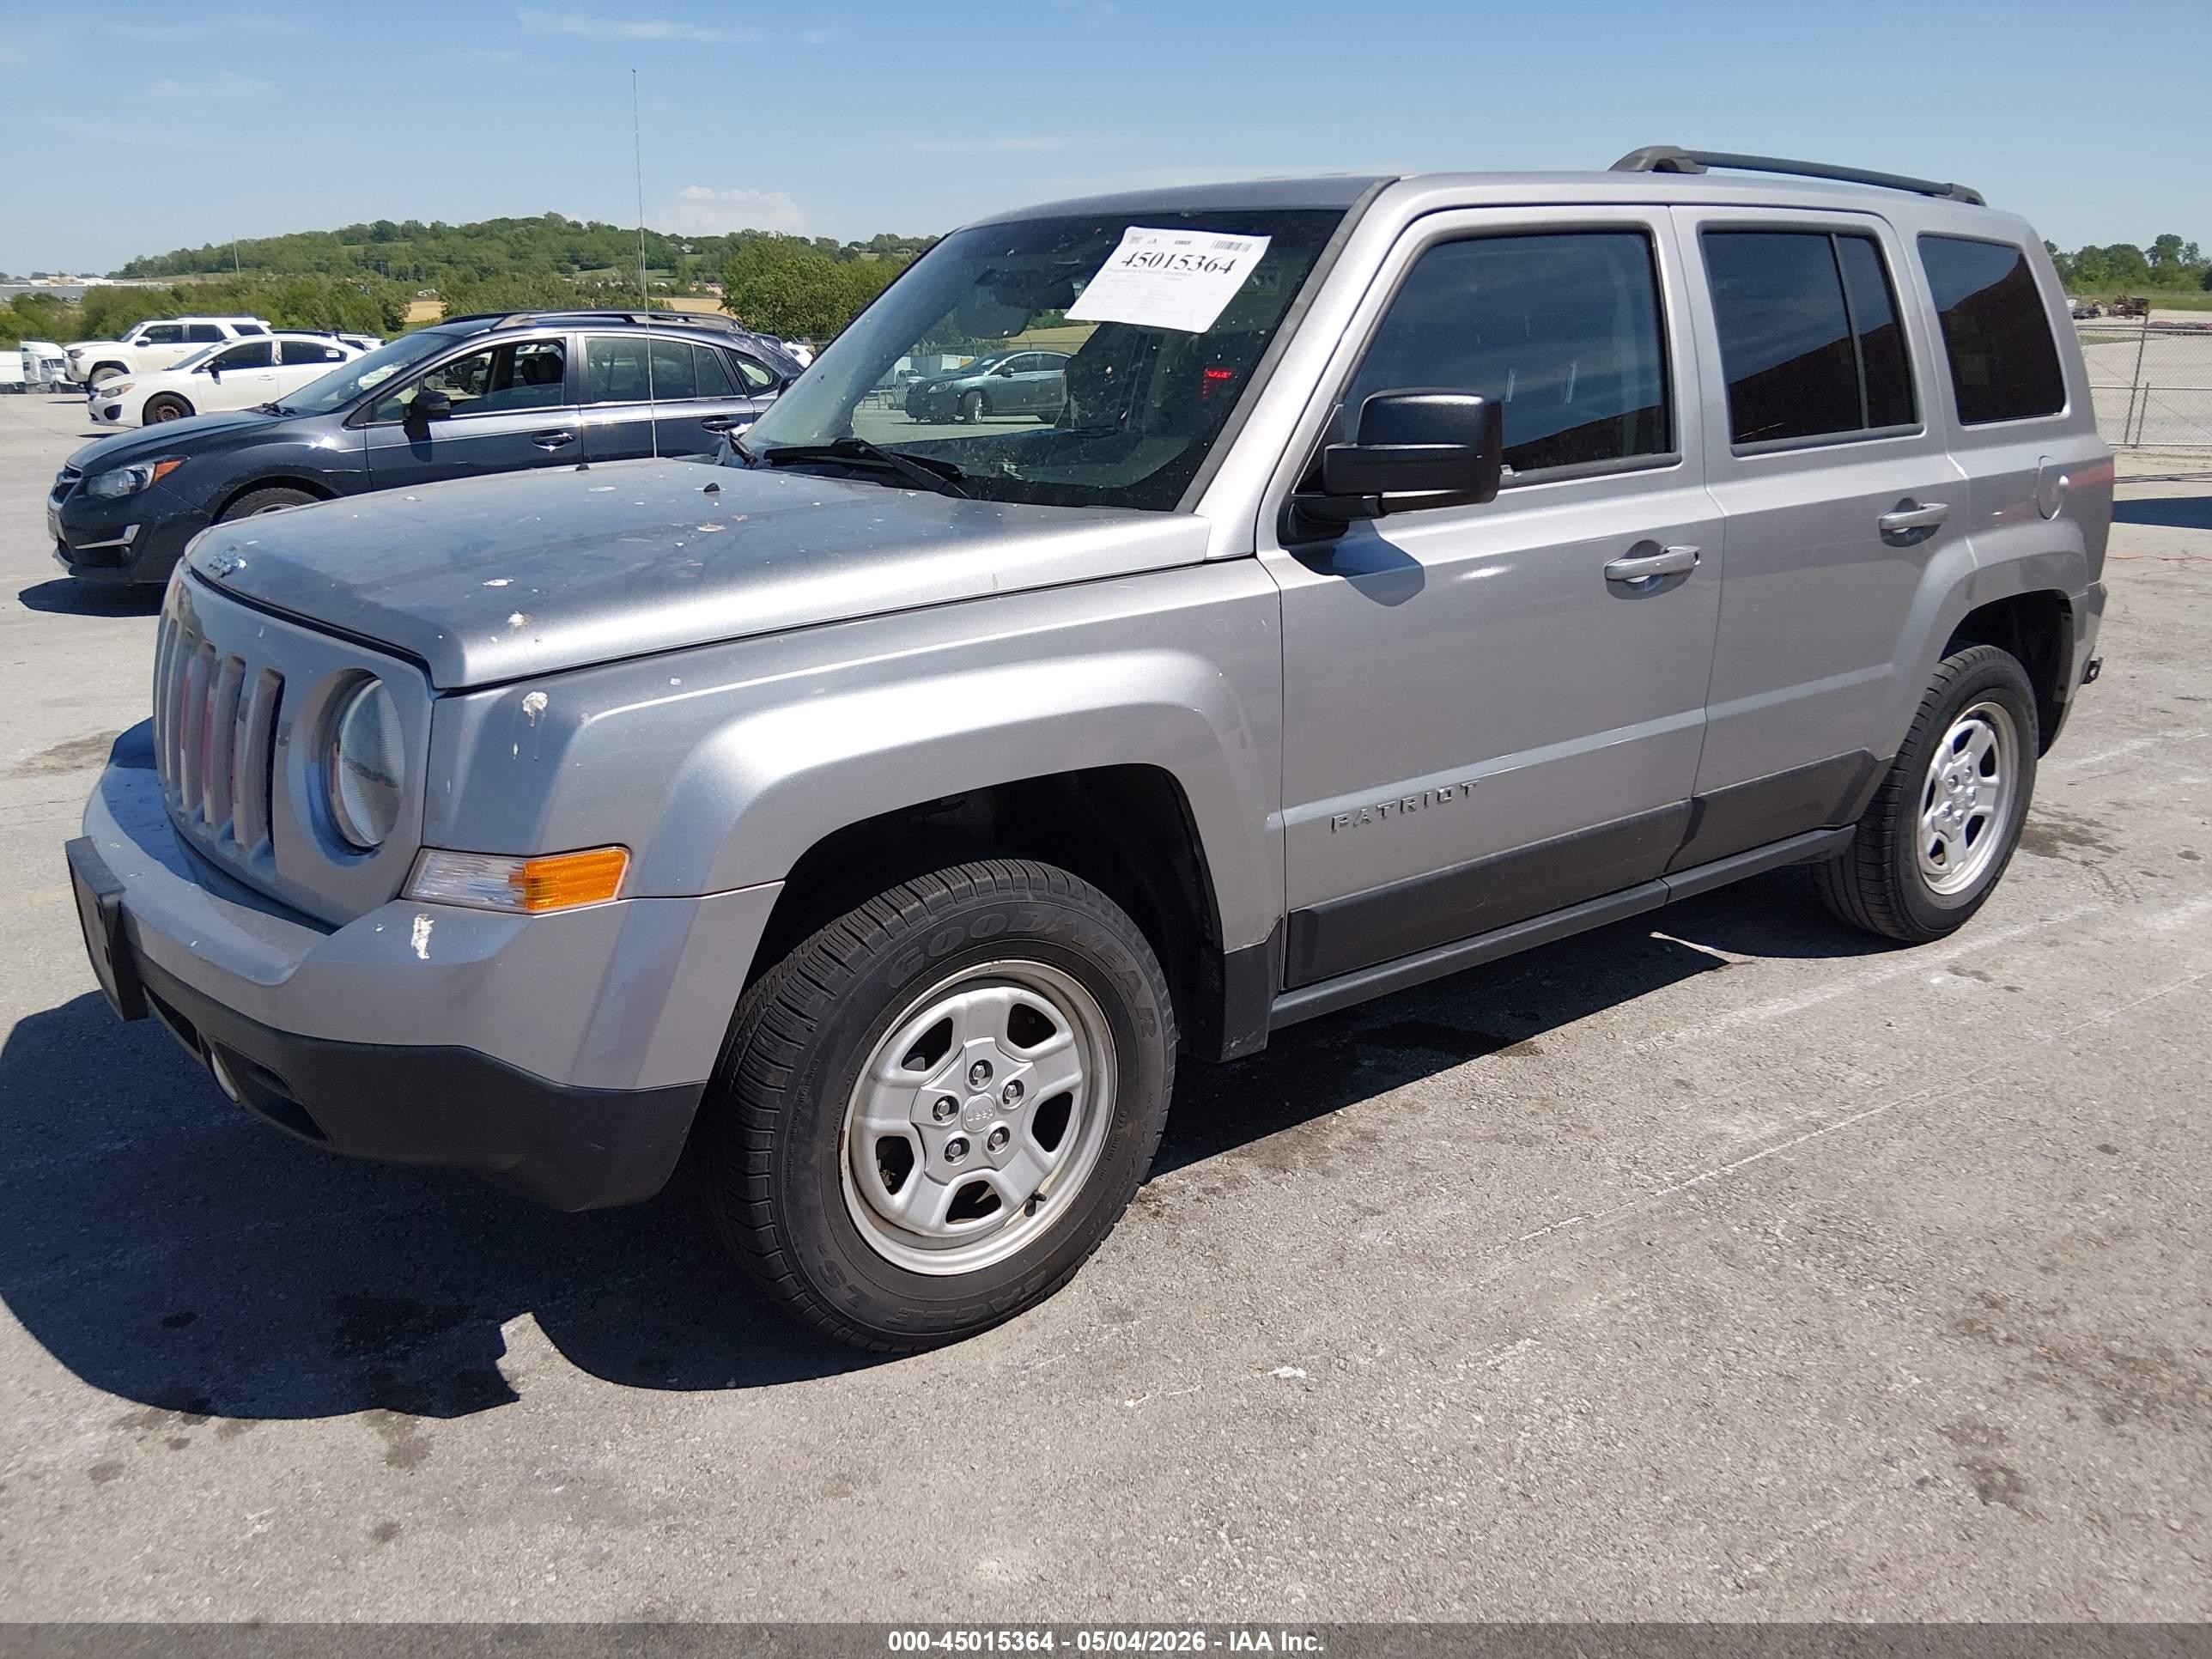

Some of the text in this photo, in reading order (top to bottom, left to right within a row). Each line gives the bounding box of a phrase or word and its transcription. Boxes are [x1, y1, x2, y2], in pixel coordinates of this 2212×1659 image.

[1121, 251, 1237, 275] 45015364
[1331, 780, 1480, 833] PATRIOT
[886, 910, 1159, 1039] GOODYEAR
